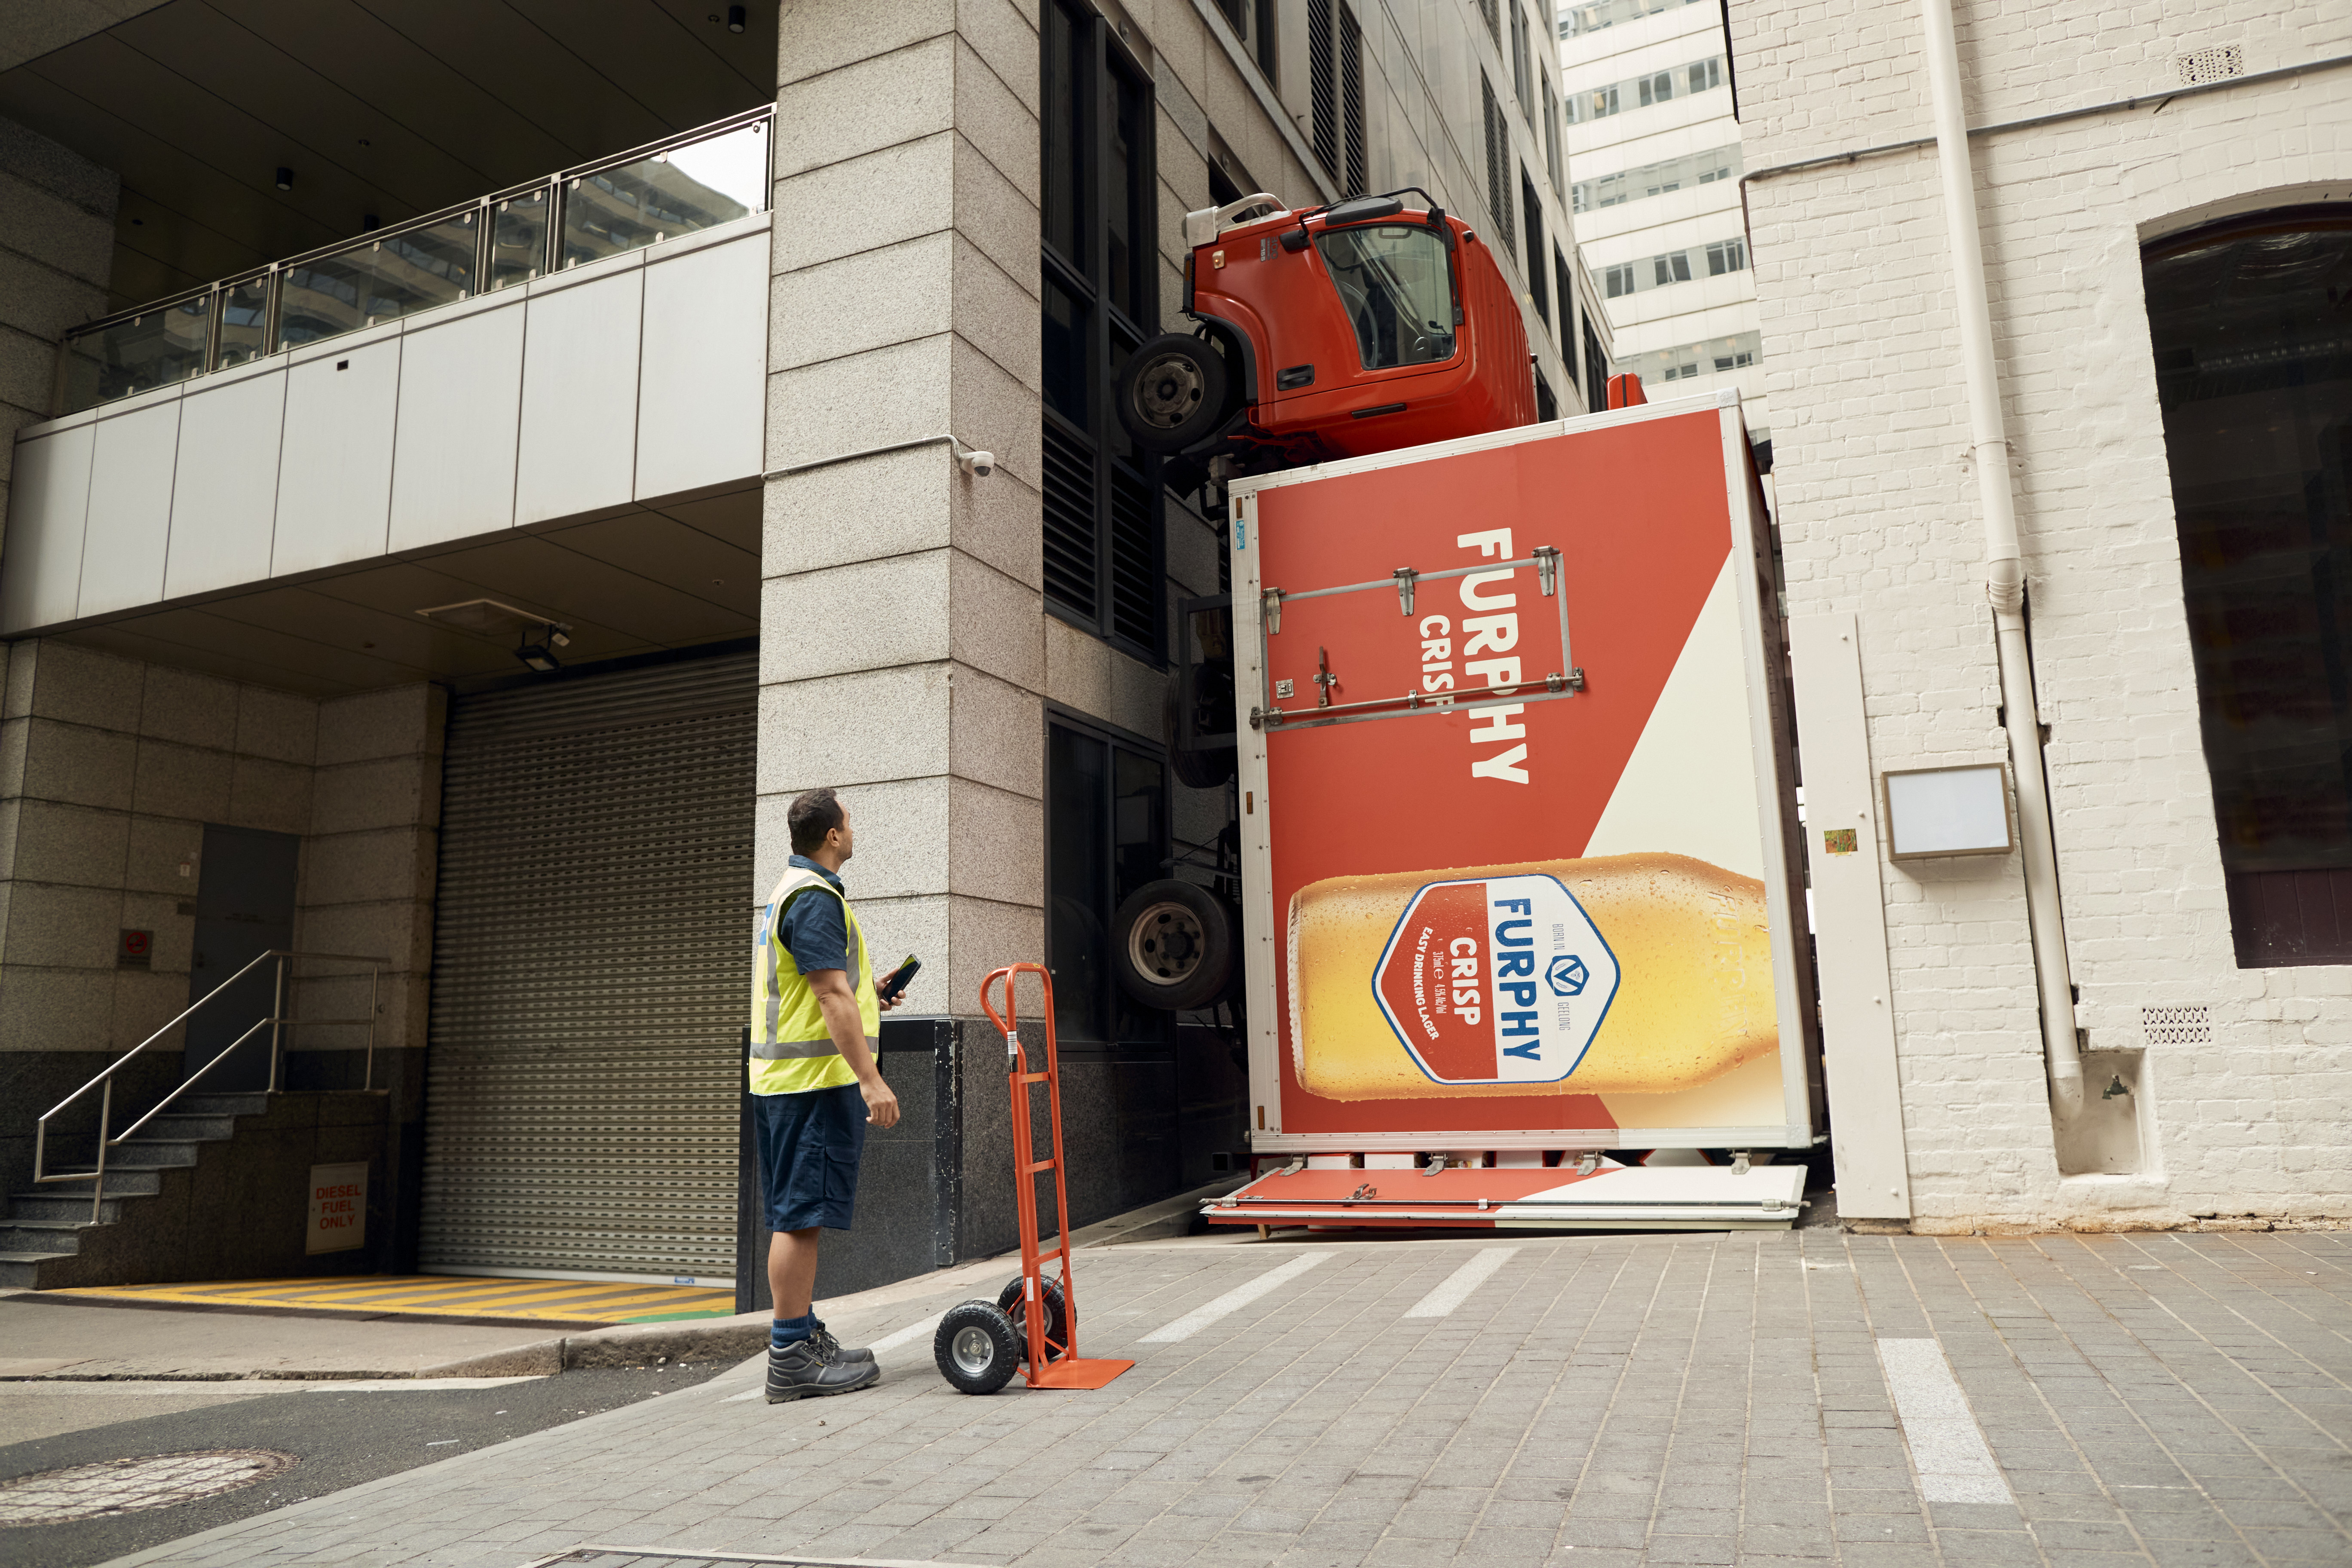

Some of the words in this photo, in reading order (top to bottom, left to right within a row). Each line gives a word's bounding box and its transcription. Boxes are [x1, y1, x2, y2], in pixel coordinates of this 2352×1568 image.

[1419, 615, 1455, 714] CRISP
[1457, 528, 1529, 784] FURPHY
[1417, 926, 1433, 952] EASY
[1553, 924, 1565, 941] BORN
[1414, 954, 1425, 1005] DRINKING
[1450, 937, 1480, 1025] CRISP
[1494, 899, 1540, 1061] FURPHY
[1418, 1007, 1439, 1040] LAGER
[1557, 1002, 1570, 1031] GEELONG
[316, 1185, 361, 1199] DIESEL
[322, 1200, 355, 1214] FUEL
[320, 1214, 355, 1230] ONLY
